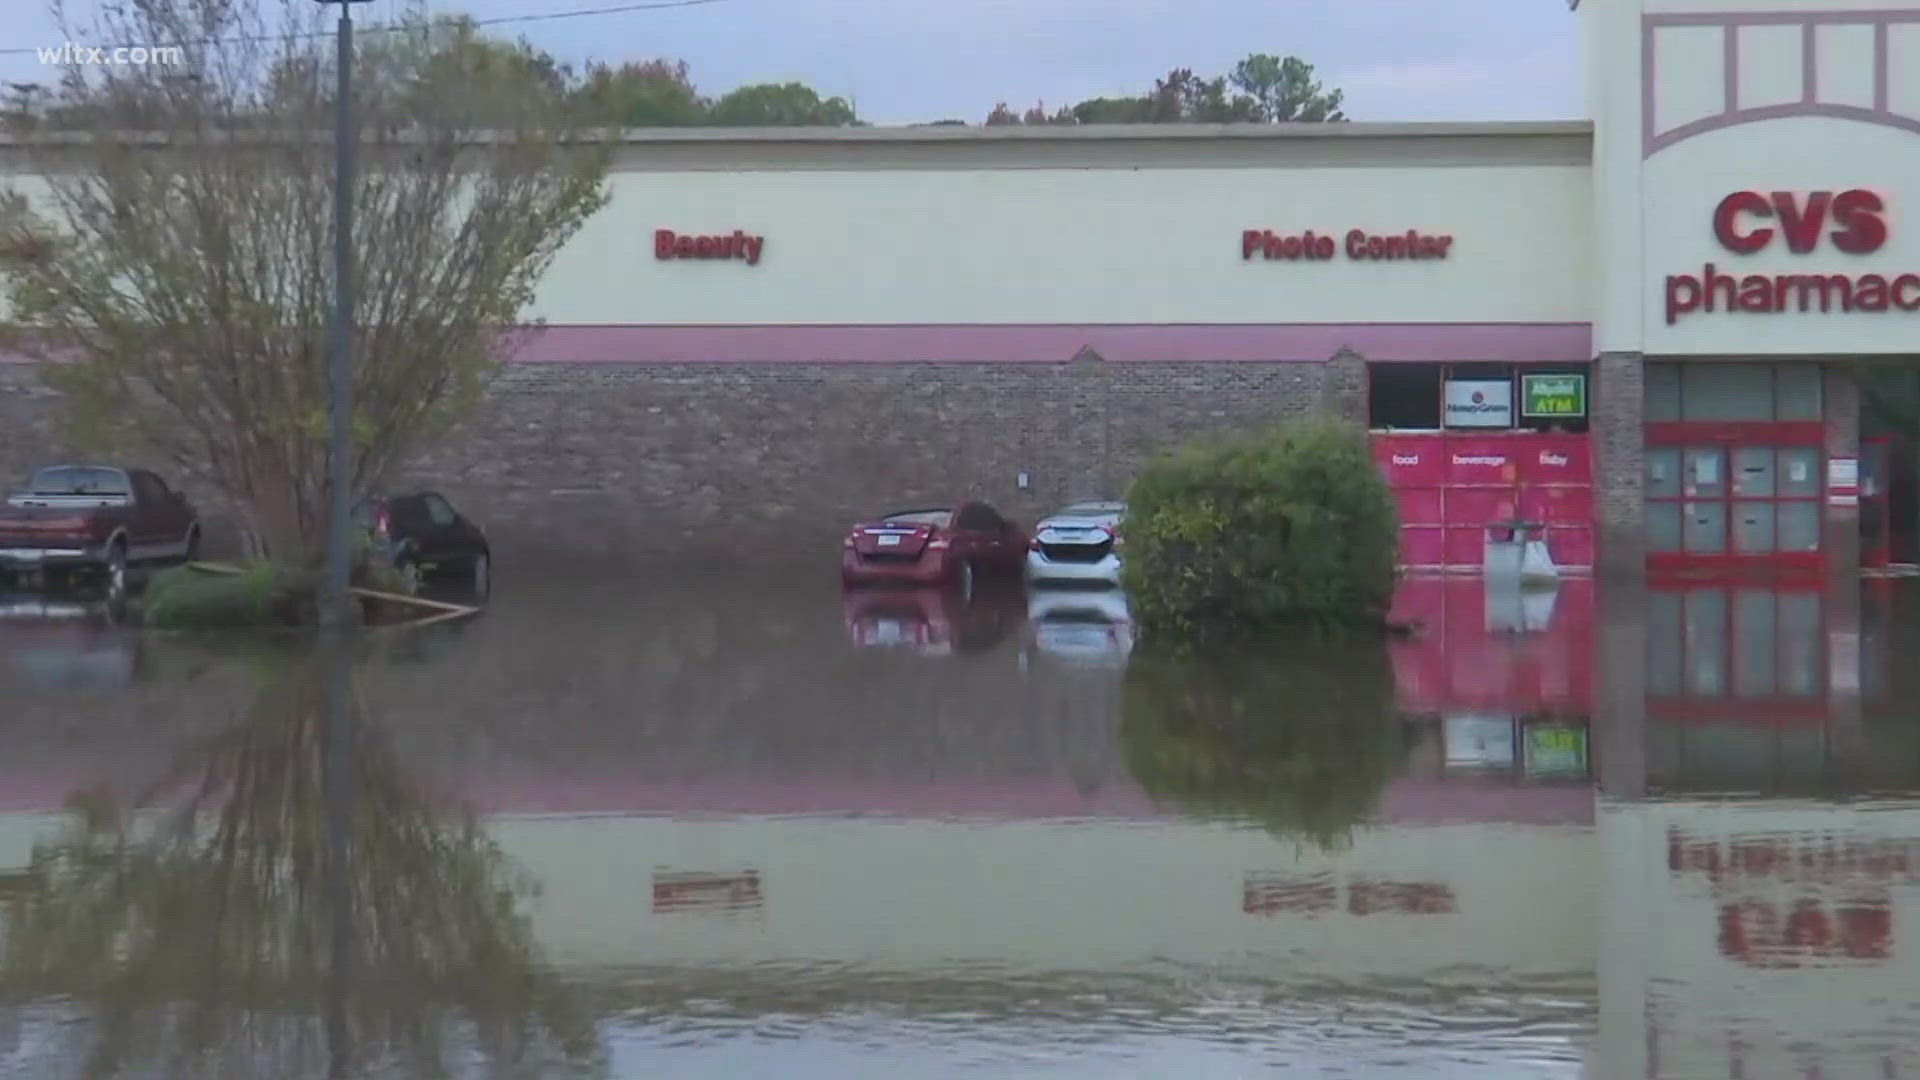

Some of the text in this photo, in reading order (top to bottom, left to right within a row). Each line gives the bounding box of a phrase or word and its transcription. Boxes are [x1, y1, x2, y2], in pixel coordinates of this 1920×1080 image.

[1713, 189, 1886, 255] CVS
[655, 229, 764, 265] Beauty
[1243, 229, 1452, 260] Photo Center
[1537, 397, 1572, 413] ATM
[1393, 454, 1418, 465] food
[1453, 454, 1506, 466] beverage
[1539, 452, 1568, 466] baby
